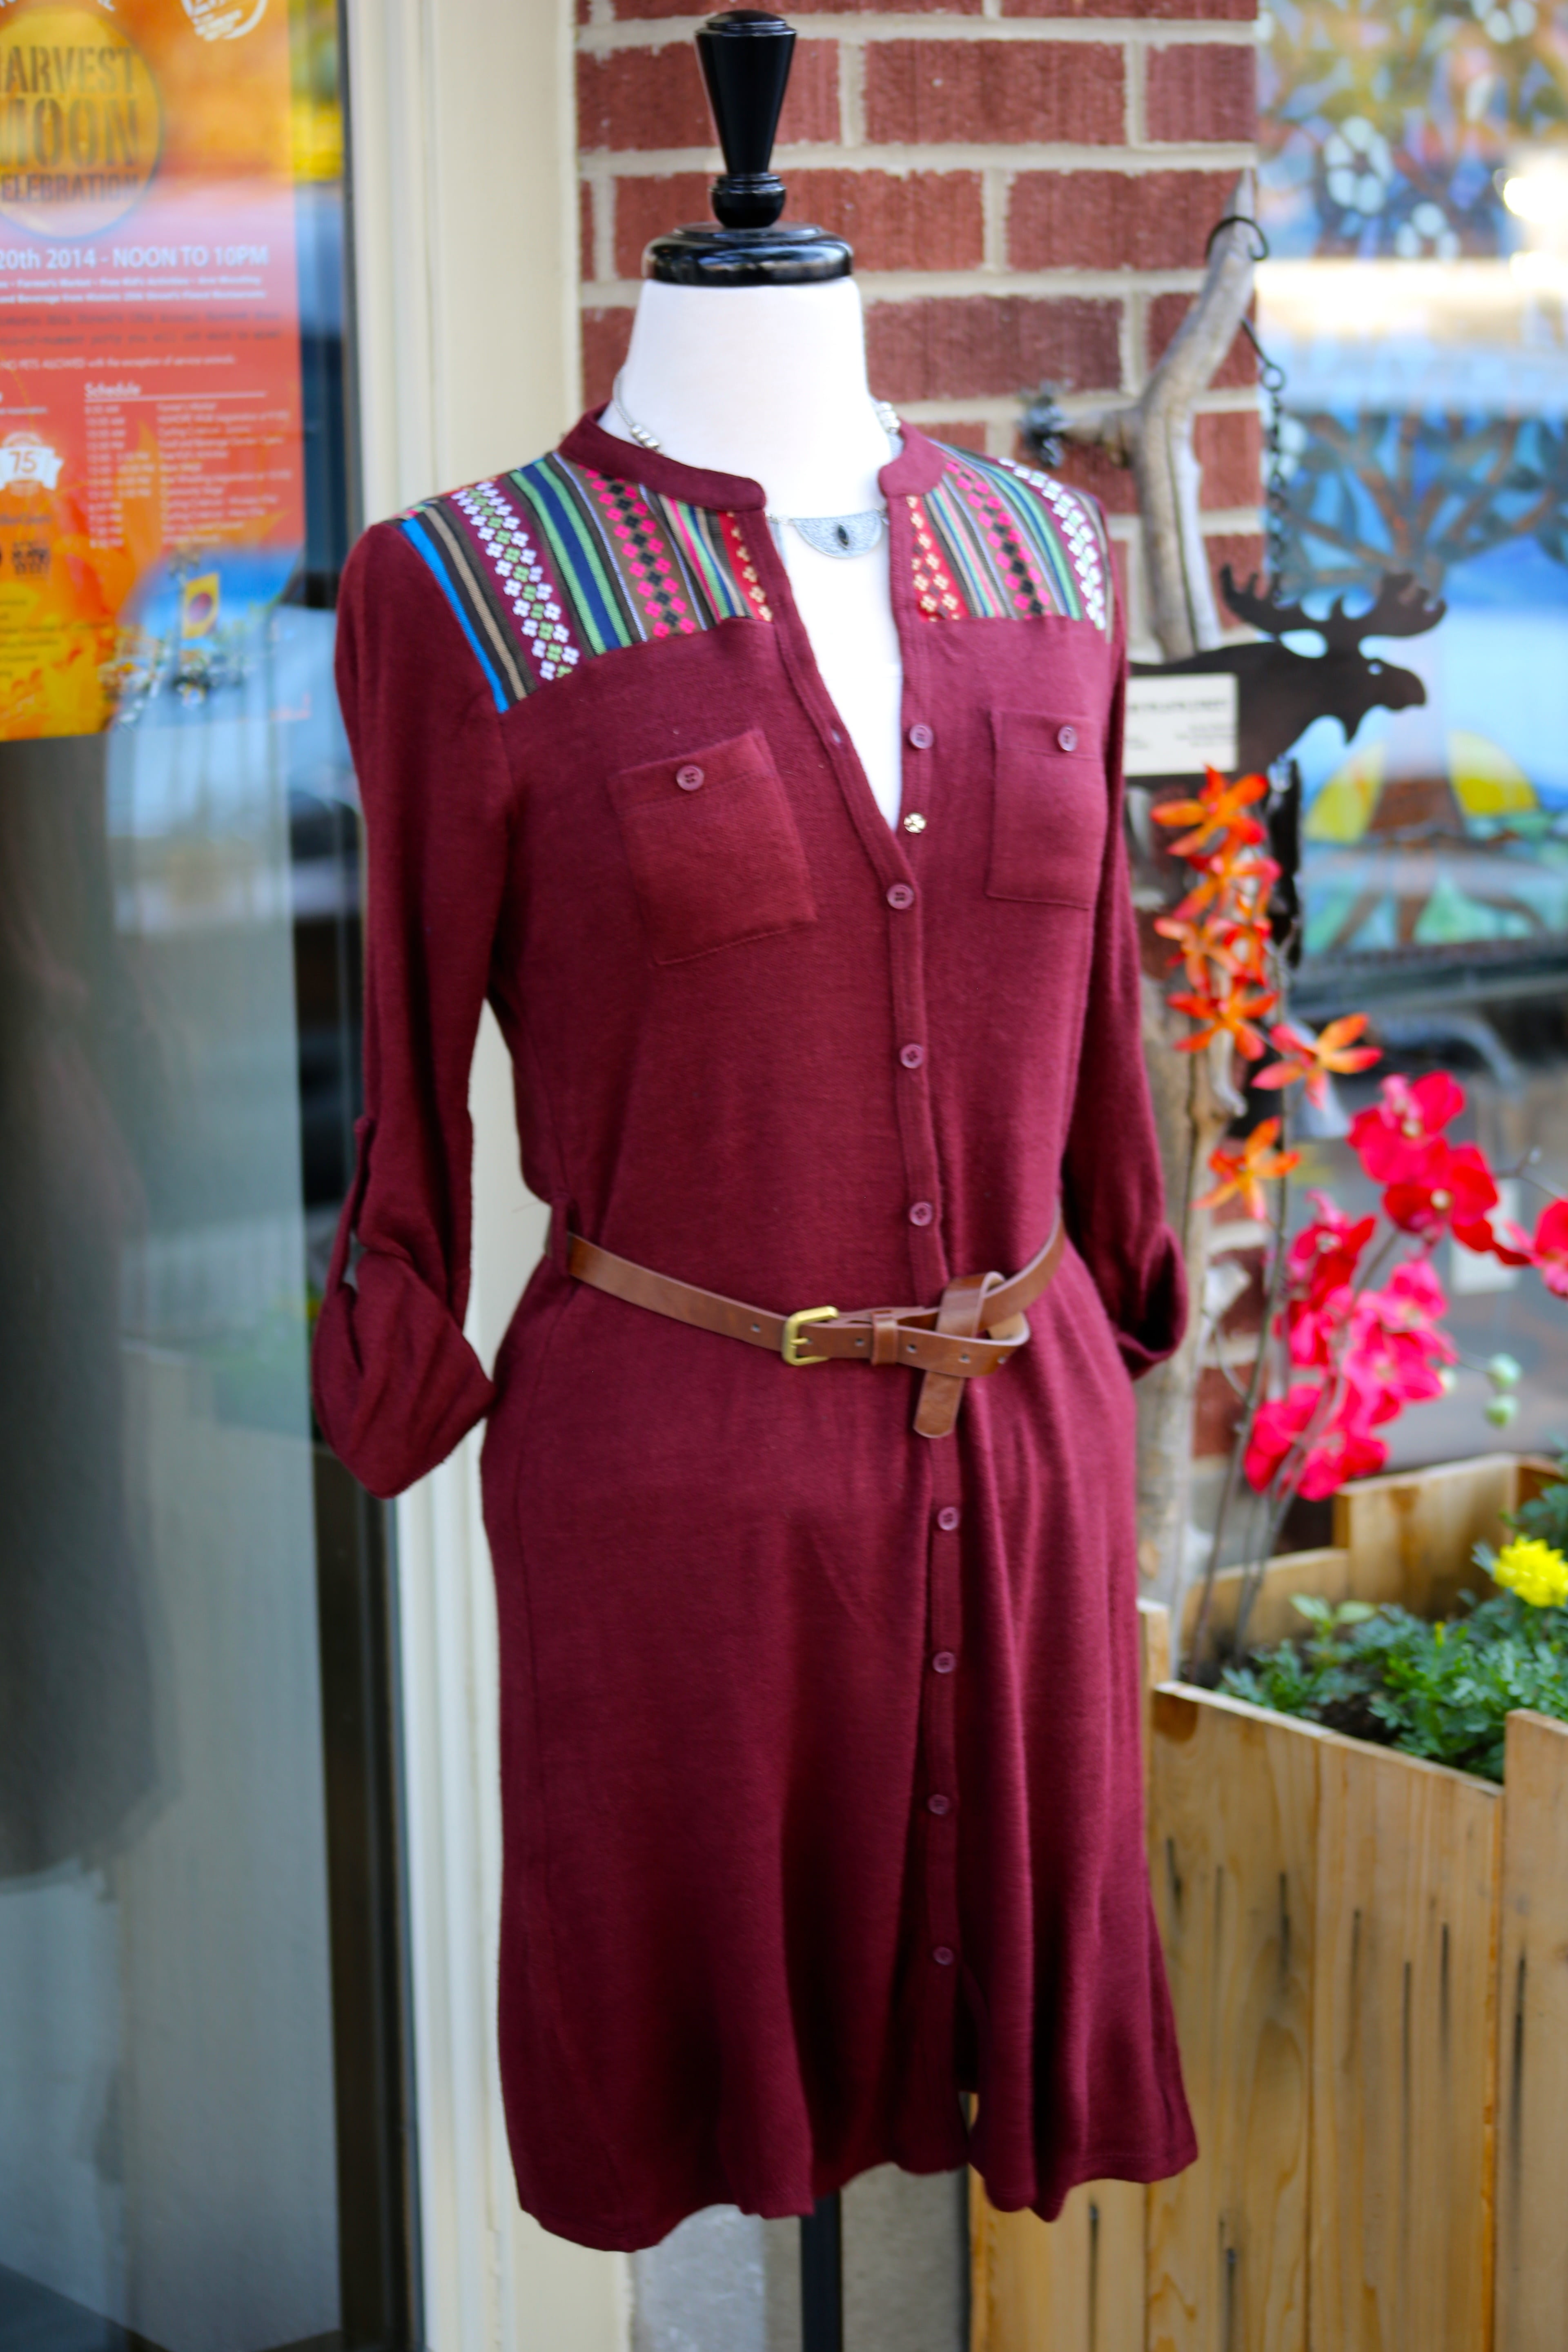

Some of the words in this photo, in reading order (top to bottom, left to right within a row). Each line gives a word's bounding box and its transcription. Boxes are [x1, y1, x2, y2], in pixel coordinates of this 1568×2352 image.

[0, 45, 133, 93] ARVEST
[1, 172, 139, 204] ELEBRATION
[0, 247, 42, 270] 20th
[46, 246, 97, 270] 2014
[112, 245, 178, 269] NOON
[180, 245, 209, 267] TO
[214, 244, 269, 267] 10PM
[85, 381, 141, 397] Schedule
[9, 450, 38, 473] 75
